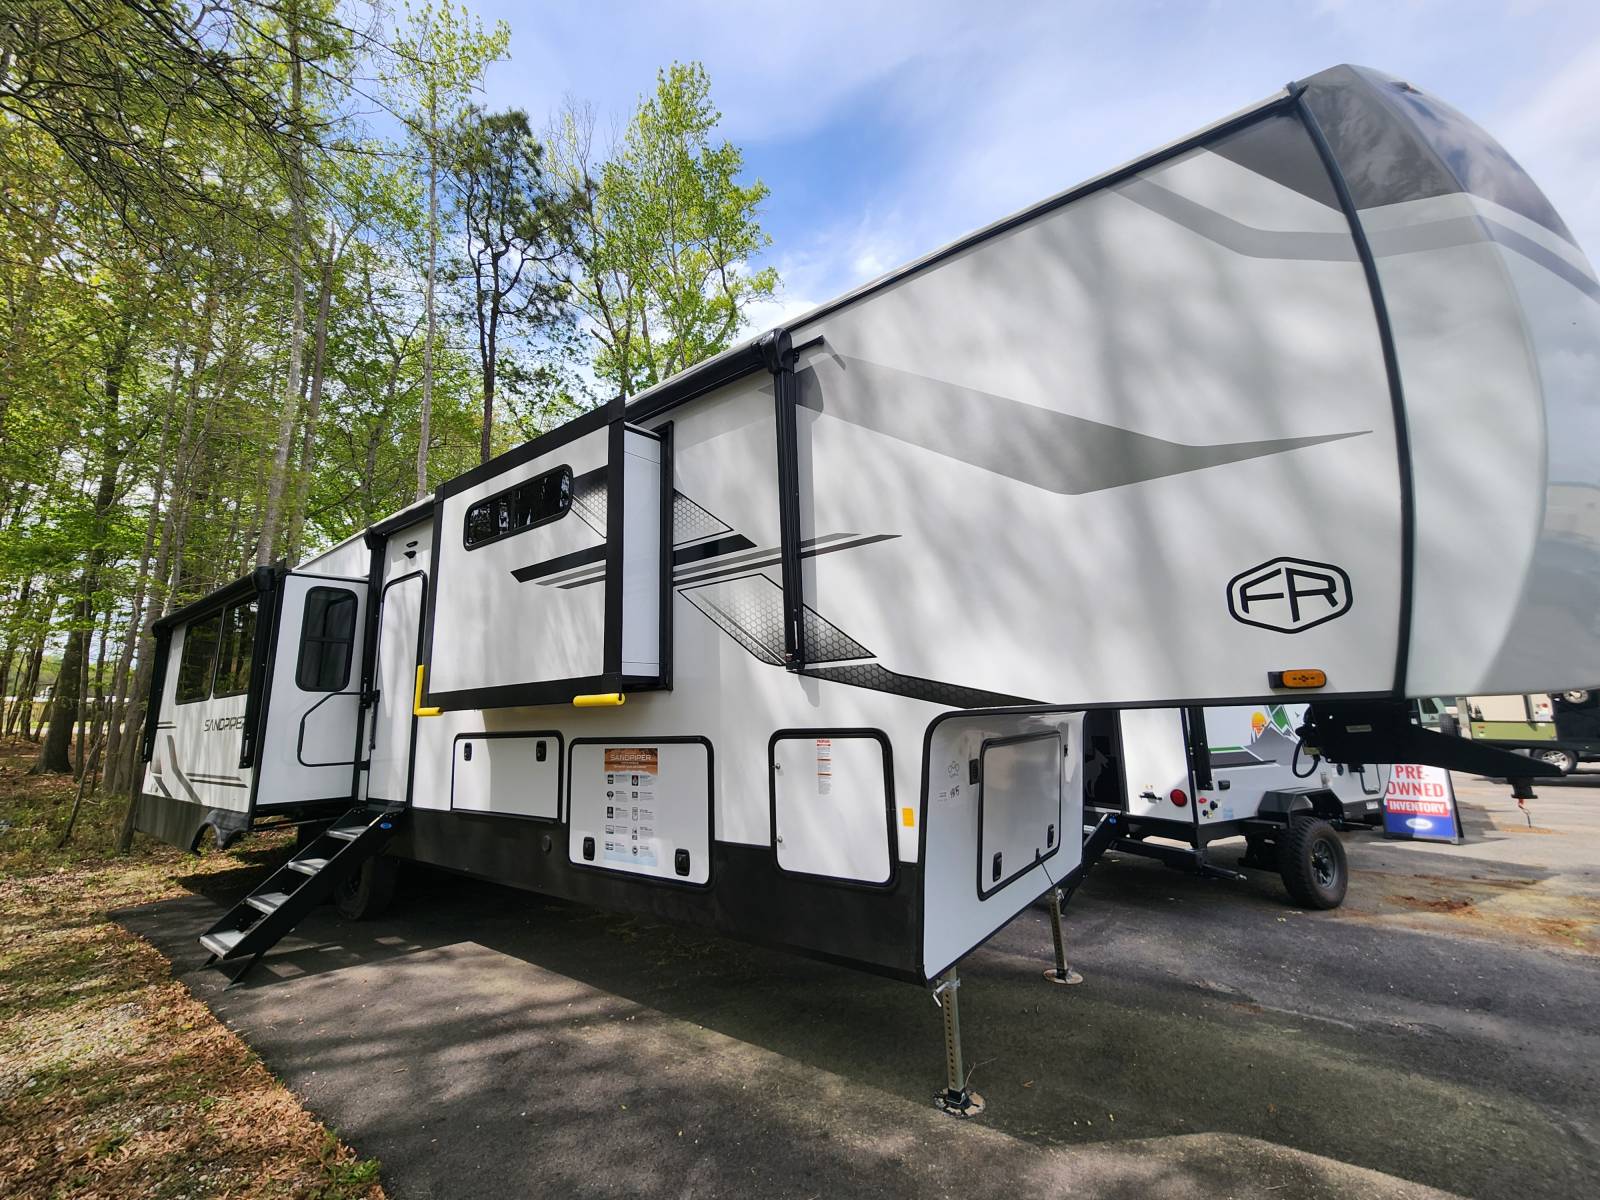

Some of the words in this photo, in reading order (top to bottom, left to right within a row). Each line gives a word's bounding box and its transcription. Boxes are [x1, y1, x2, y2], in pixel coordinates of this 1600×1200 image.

[1395, 765, 1430, 780] PRE-
[1386, 781, 1444, 798] OWNED
[1389, 801, 1444, 814] INVENTORY
